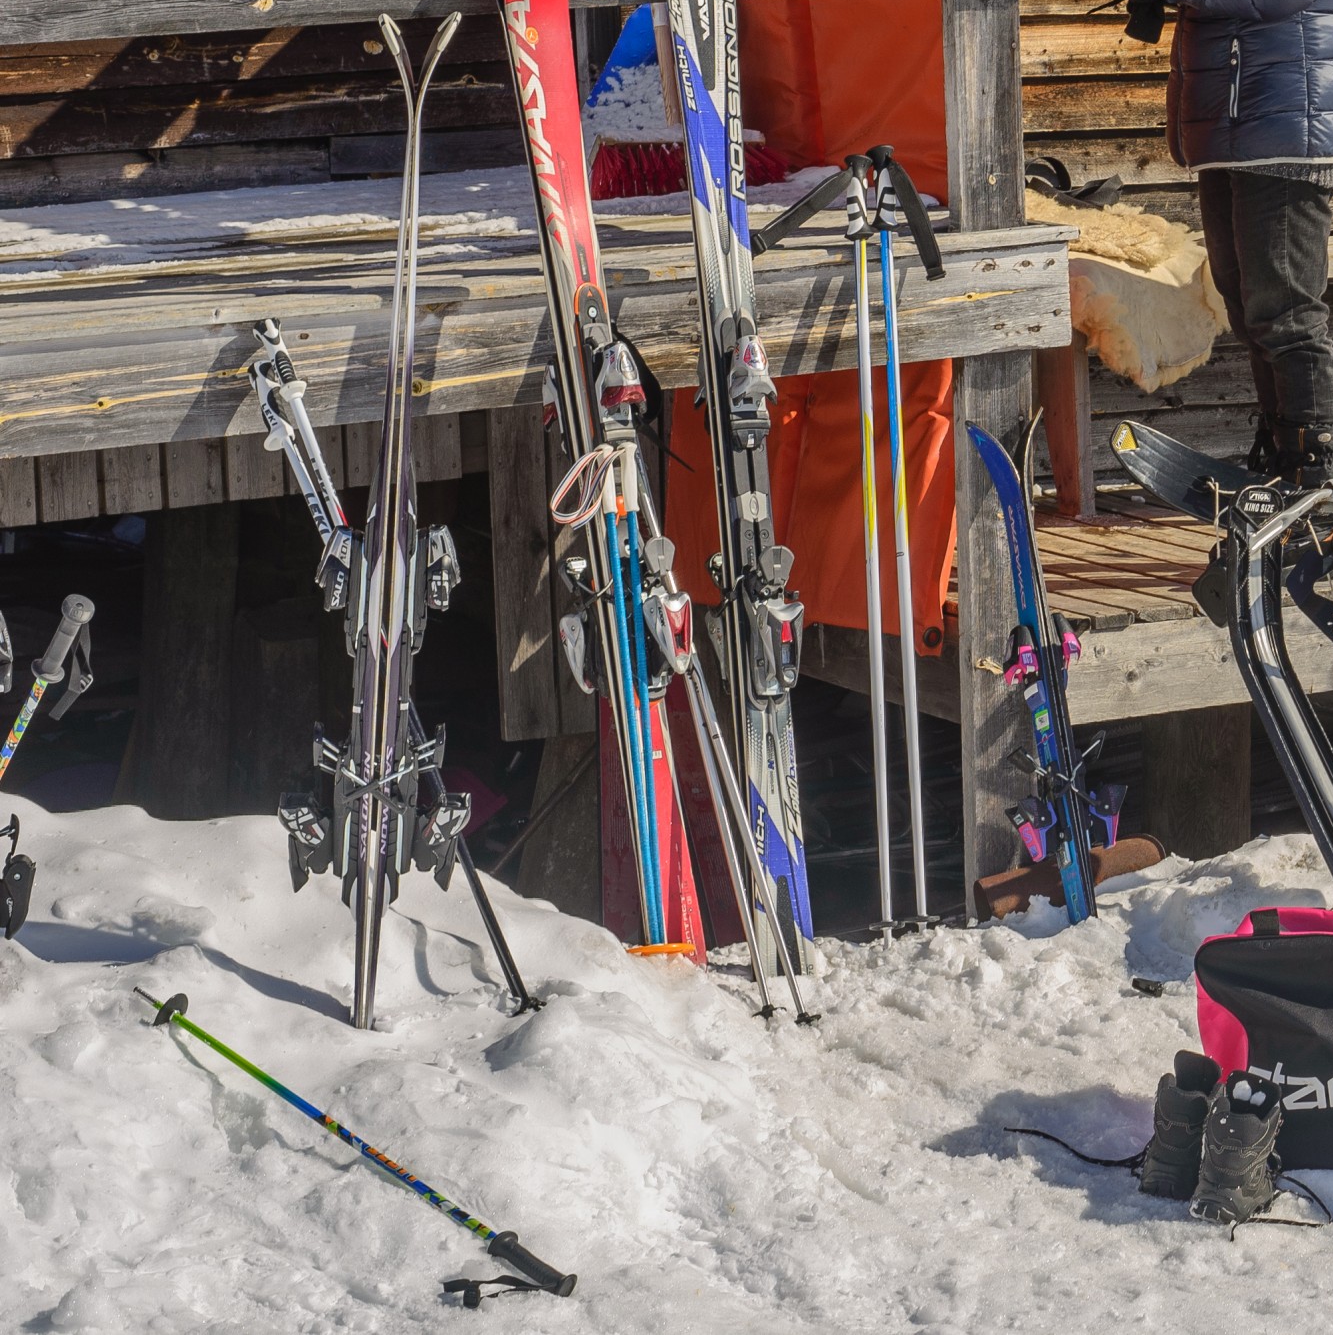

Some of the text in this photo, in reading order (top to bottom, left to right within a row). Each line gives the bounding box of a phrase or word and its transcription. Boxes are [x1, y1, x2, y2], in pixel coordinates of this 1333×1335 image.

[261, 402, 278, 427] LEKI
[304, 492, 331, 535] LEKI
[1244, 502, 1275, 514] KING SIZE
